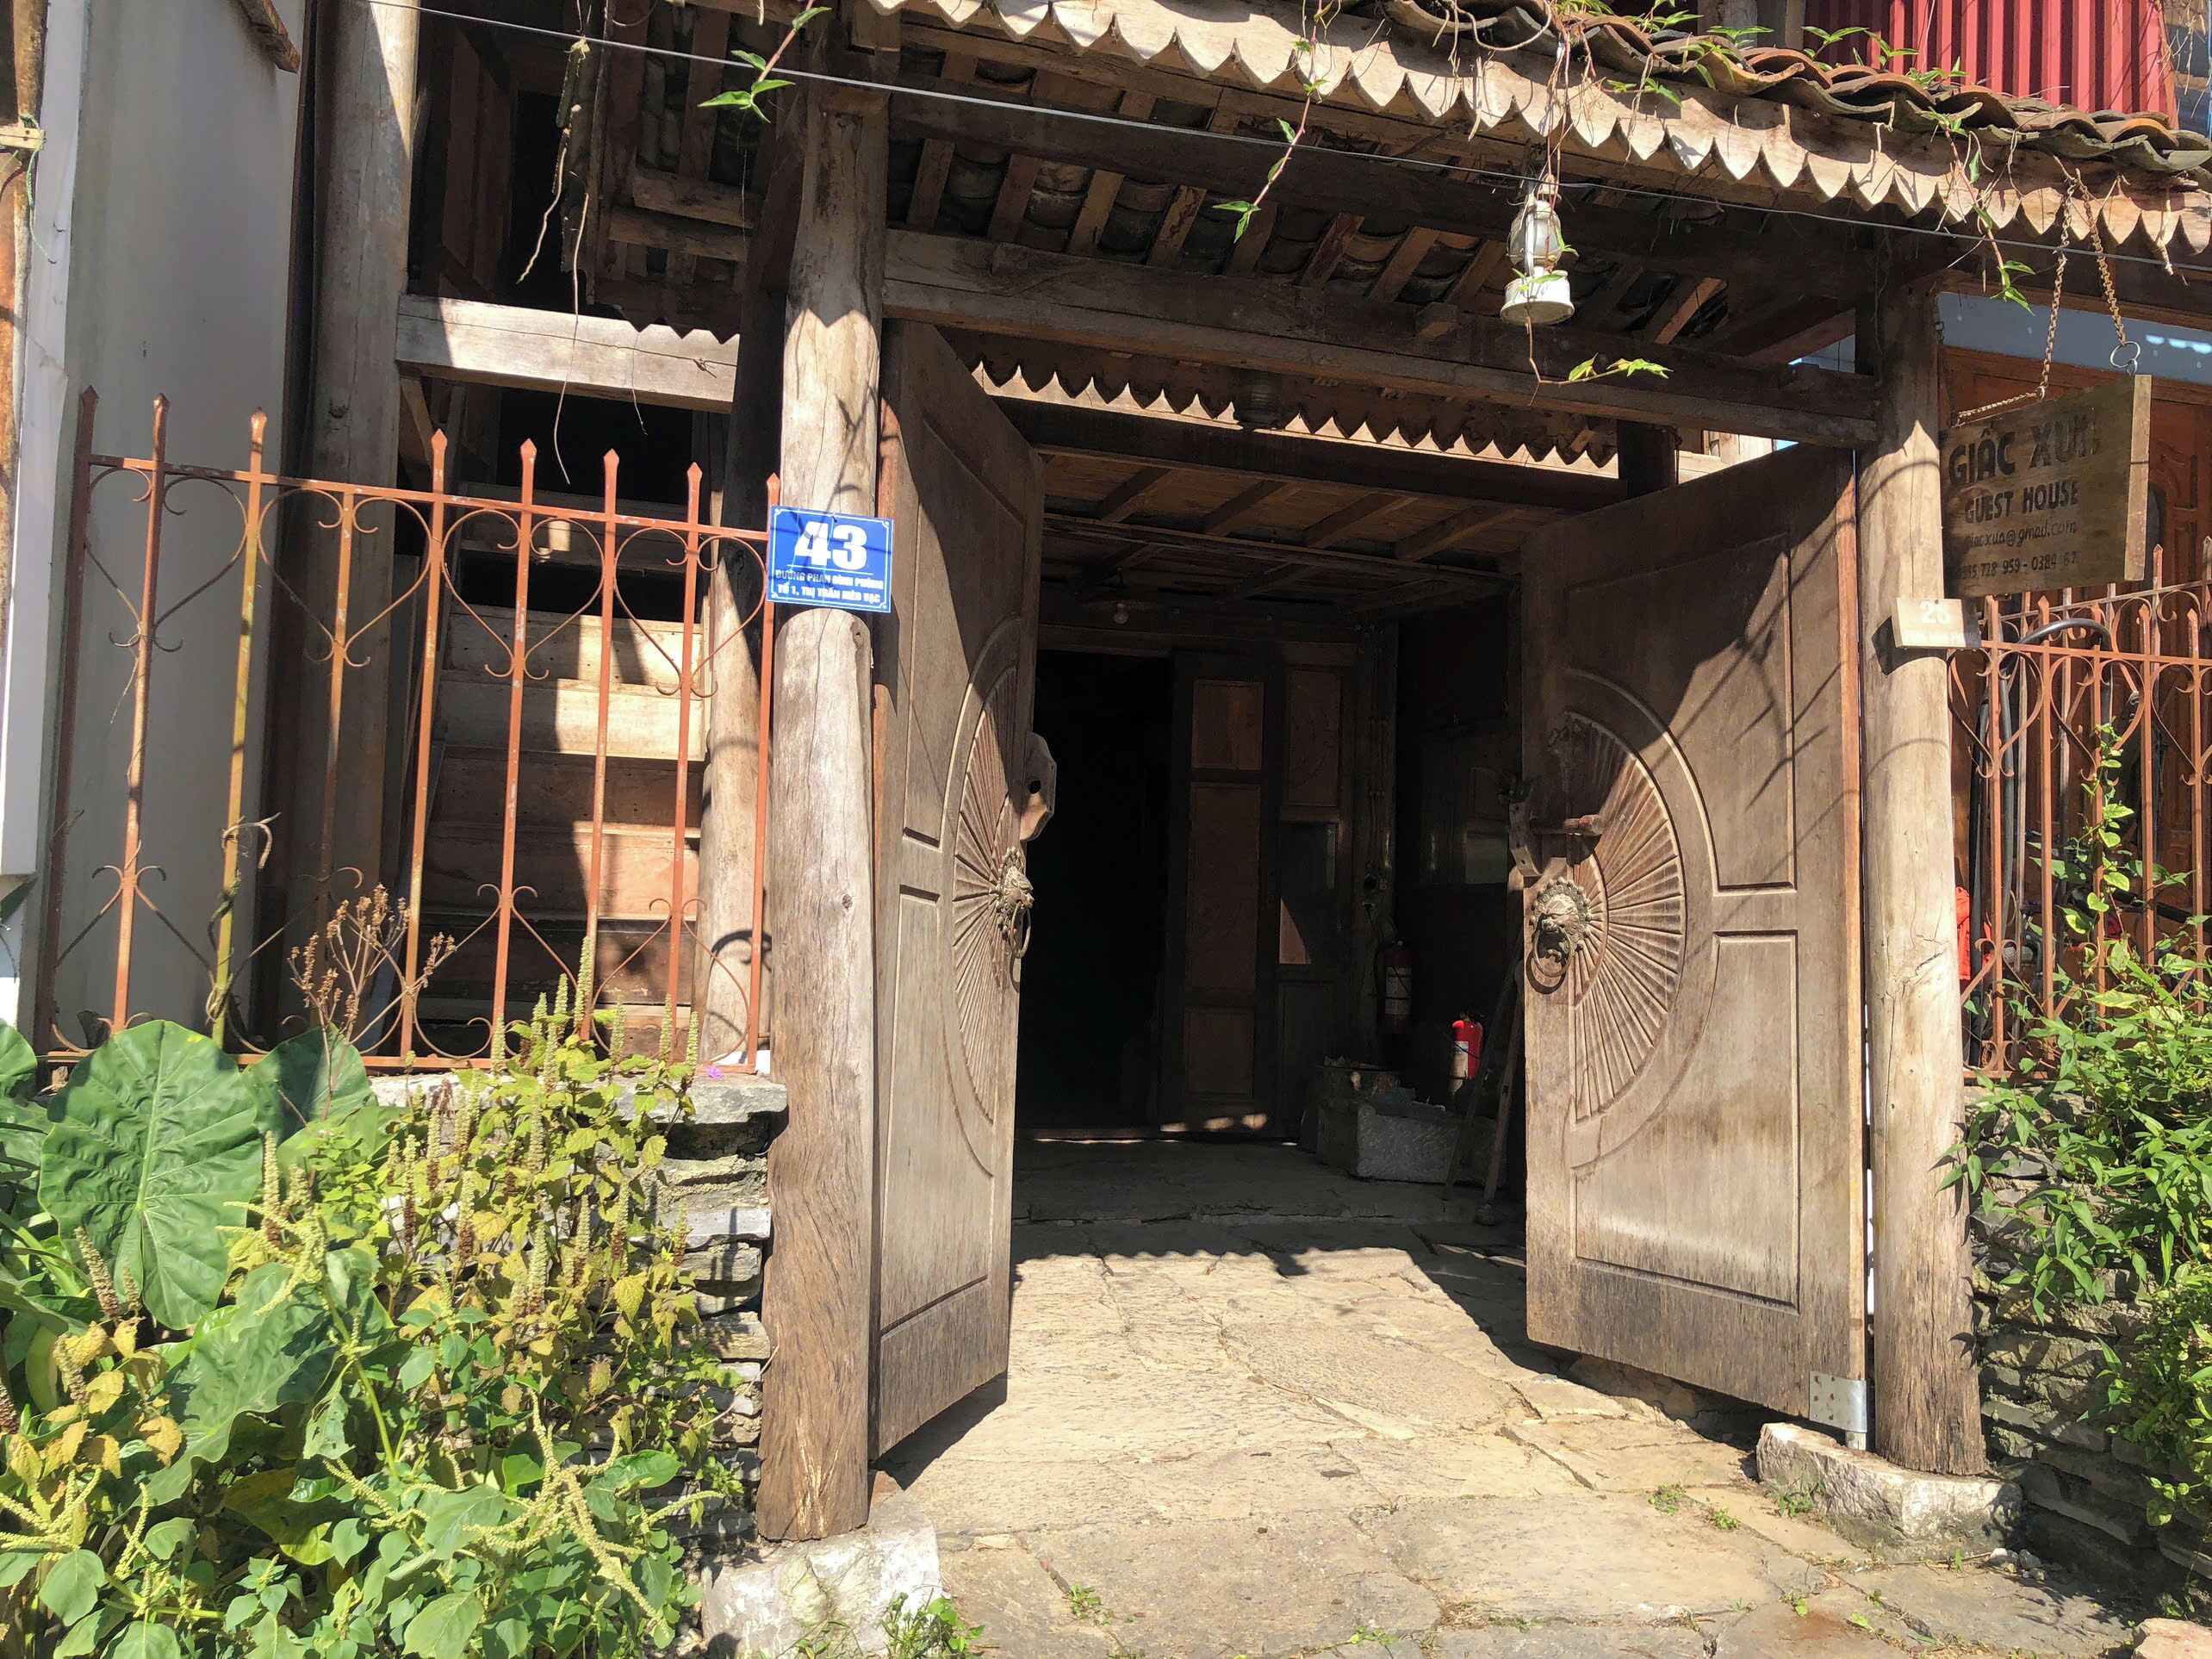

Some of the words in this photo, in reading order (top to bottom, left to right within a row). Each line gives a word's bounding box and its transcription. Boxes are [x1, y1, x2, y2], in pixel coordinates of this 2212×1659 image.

[1965, 491, 2014, 524] GUEST
[2022, 479, 2079, 513] HOUSE
[794, 521, 868, 570] 43
[807, 573, 830, 583] PHAN
